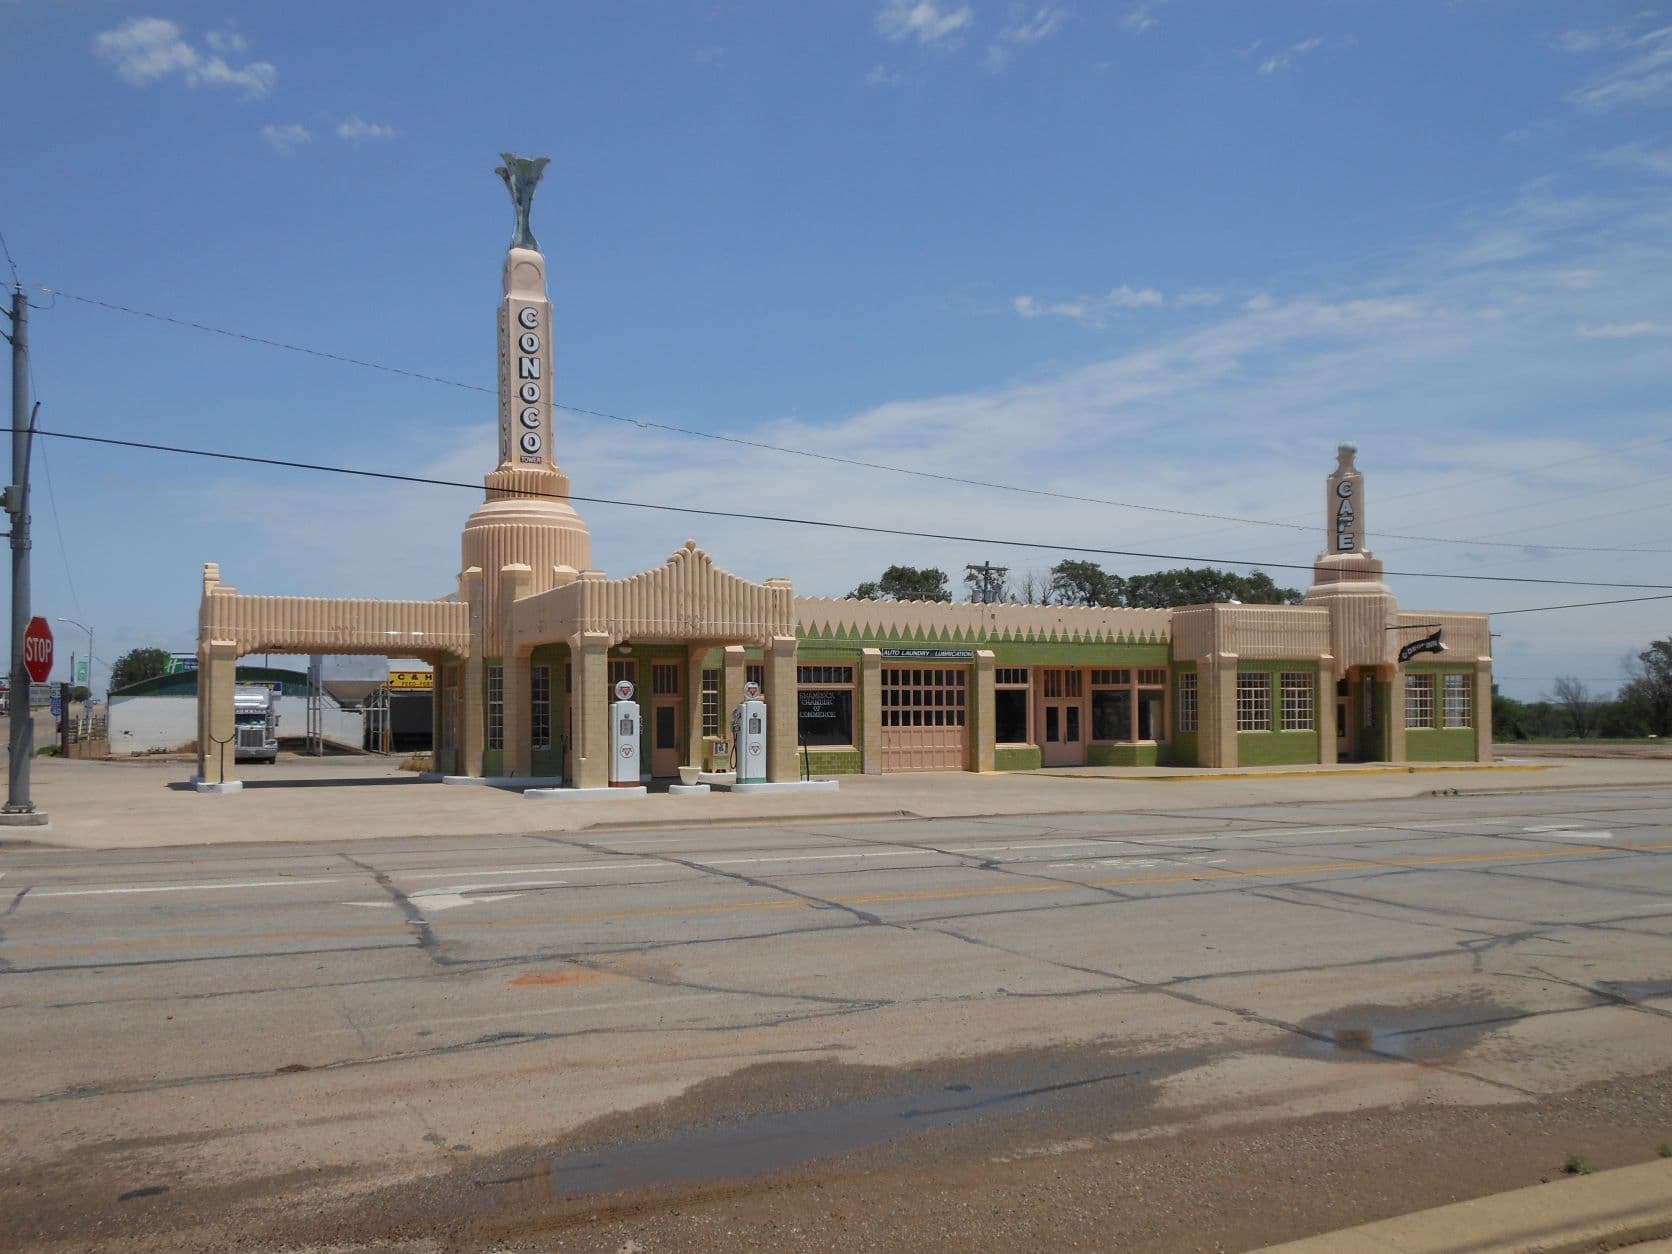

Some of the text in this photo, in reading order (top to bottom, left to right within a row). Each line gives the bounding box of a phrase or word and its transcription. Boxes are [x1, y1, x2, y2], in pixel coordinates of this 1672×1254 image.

[519, 307, 542, 454] CONOCO
[1337, 481, 1355, 550] CAFE
[26, 637, 52, 663] STOP
